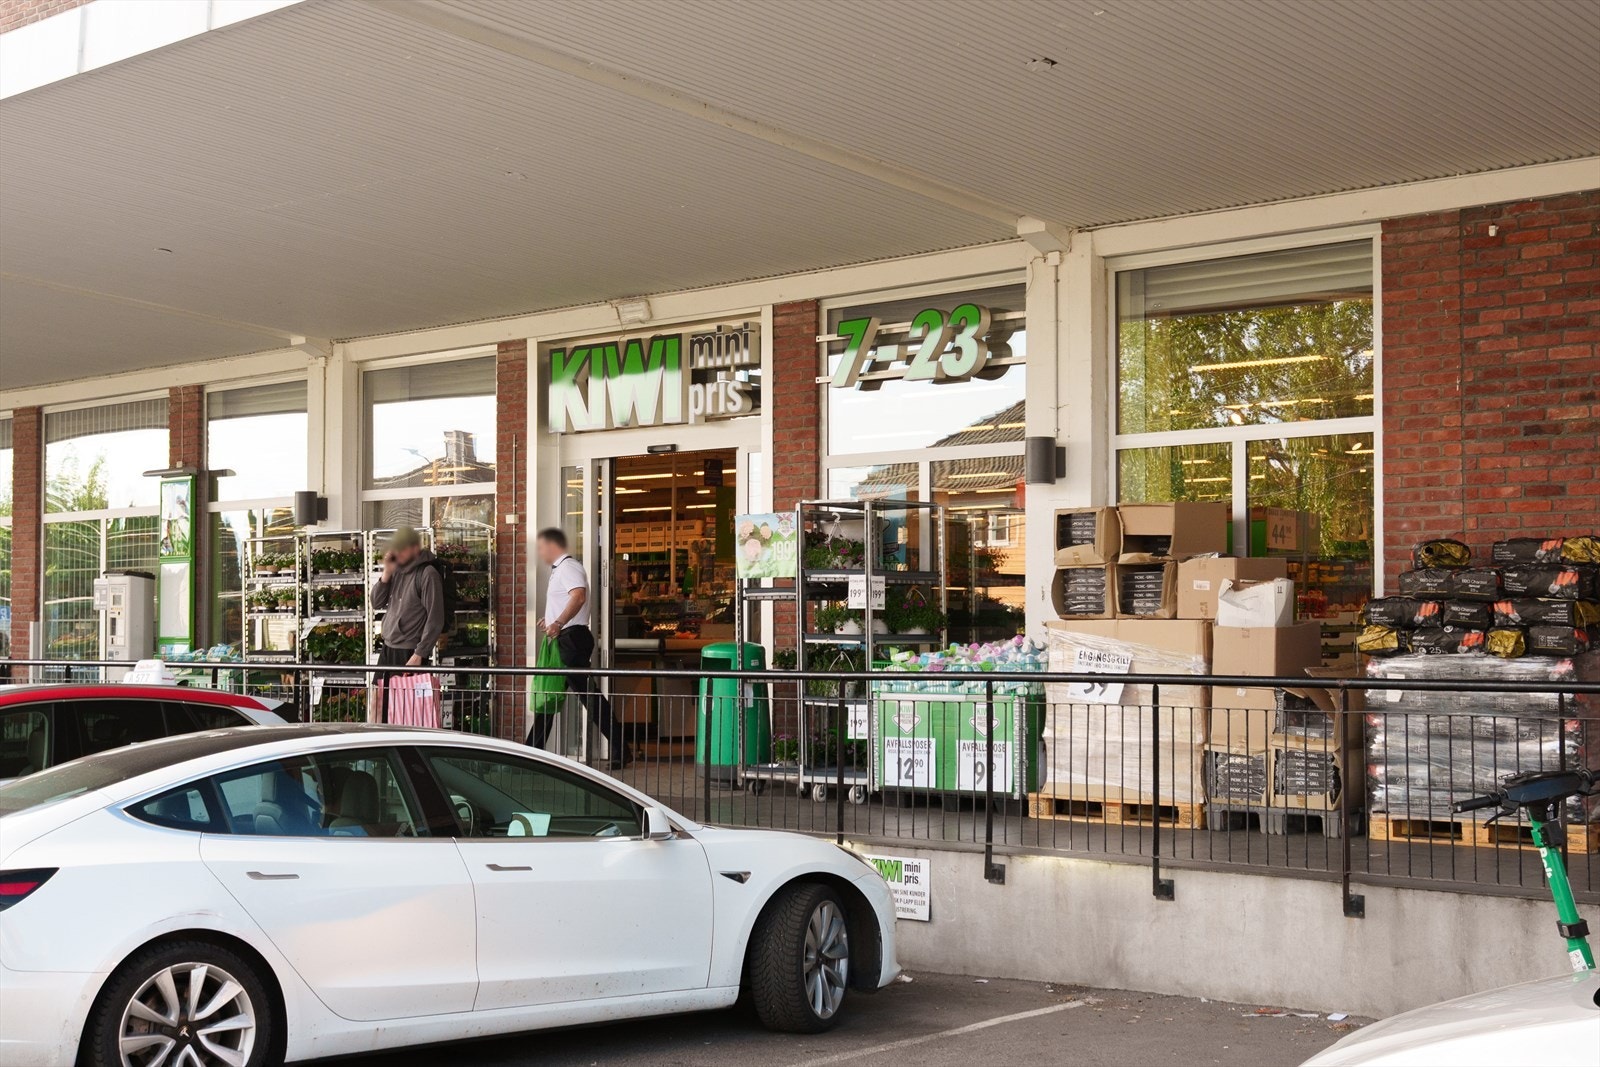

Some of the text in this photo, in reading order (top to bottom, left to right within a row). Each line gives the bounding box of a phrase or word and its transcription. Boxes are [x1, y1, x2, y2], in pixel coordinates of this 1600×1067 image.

[689, 321, 752, 369] mini
[831, 317, 876, 388] 7
[902, 303, 984, 382] 23
[549, 333, 682, 433] KIWI
[689, 380, 745, 424] pris
[904, 861, 921, 873] mini
